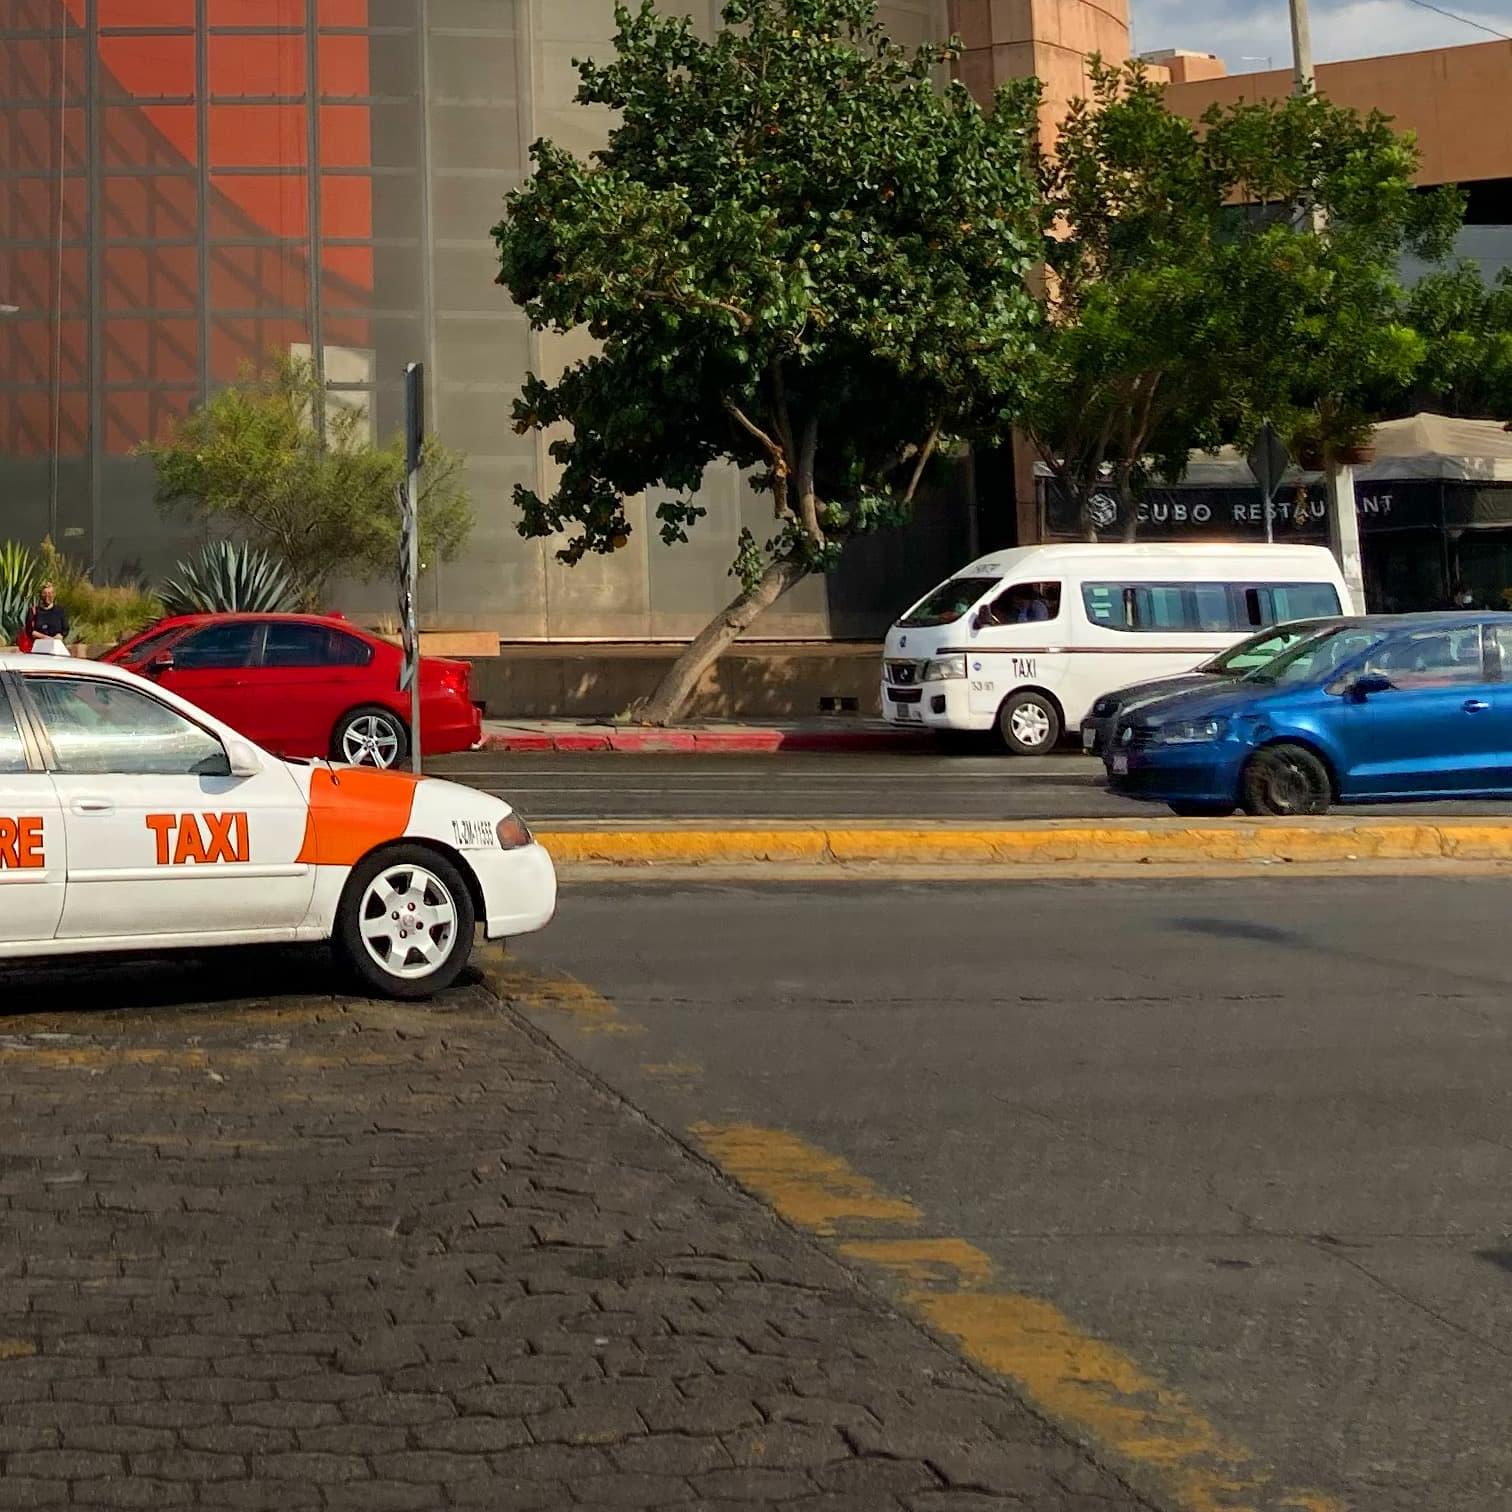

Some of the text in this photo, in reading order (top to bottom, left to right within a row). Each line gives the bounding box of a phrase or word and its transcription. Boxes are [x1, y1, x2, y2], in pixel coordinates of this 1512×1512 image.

[1137, 502, 1212, 522] CUBO
[1012, 657, 1037, 678] TAXI
[145, 811, 250, 865] TAXI
